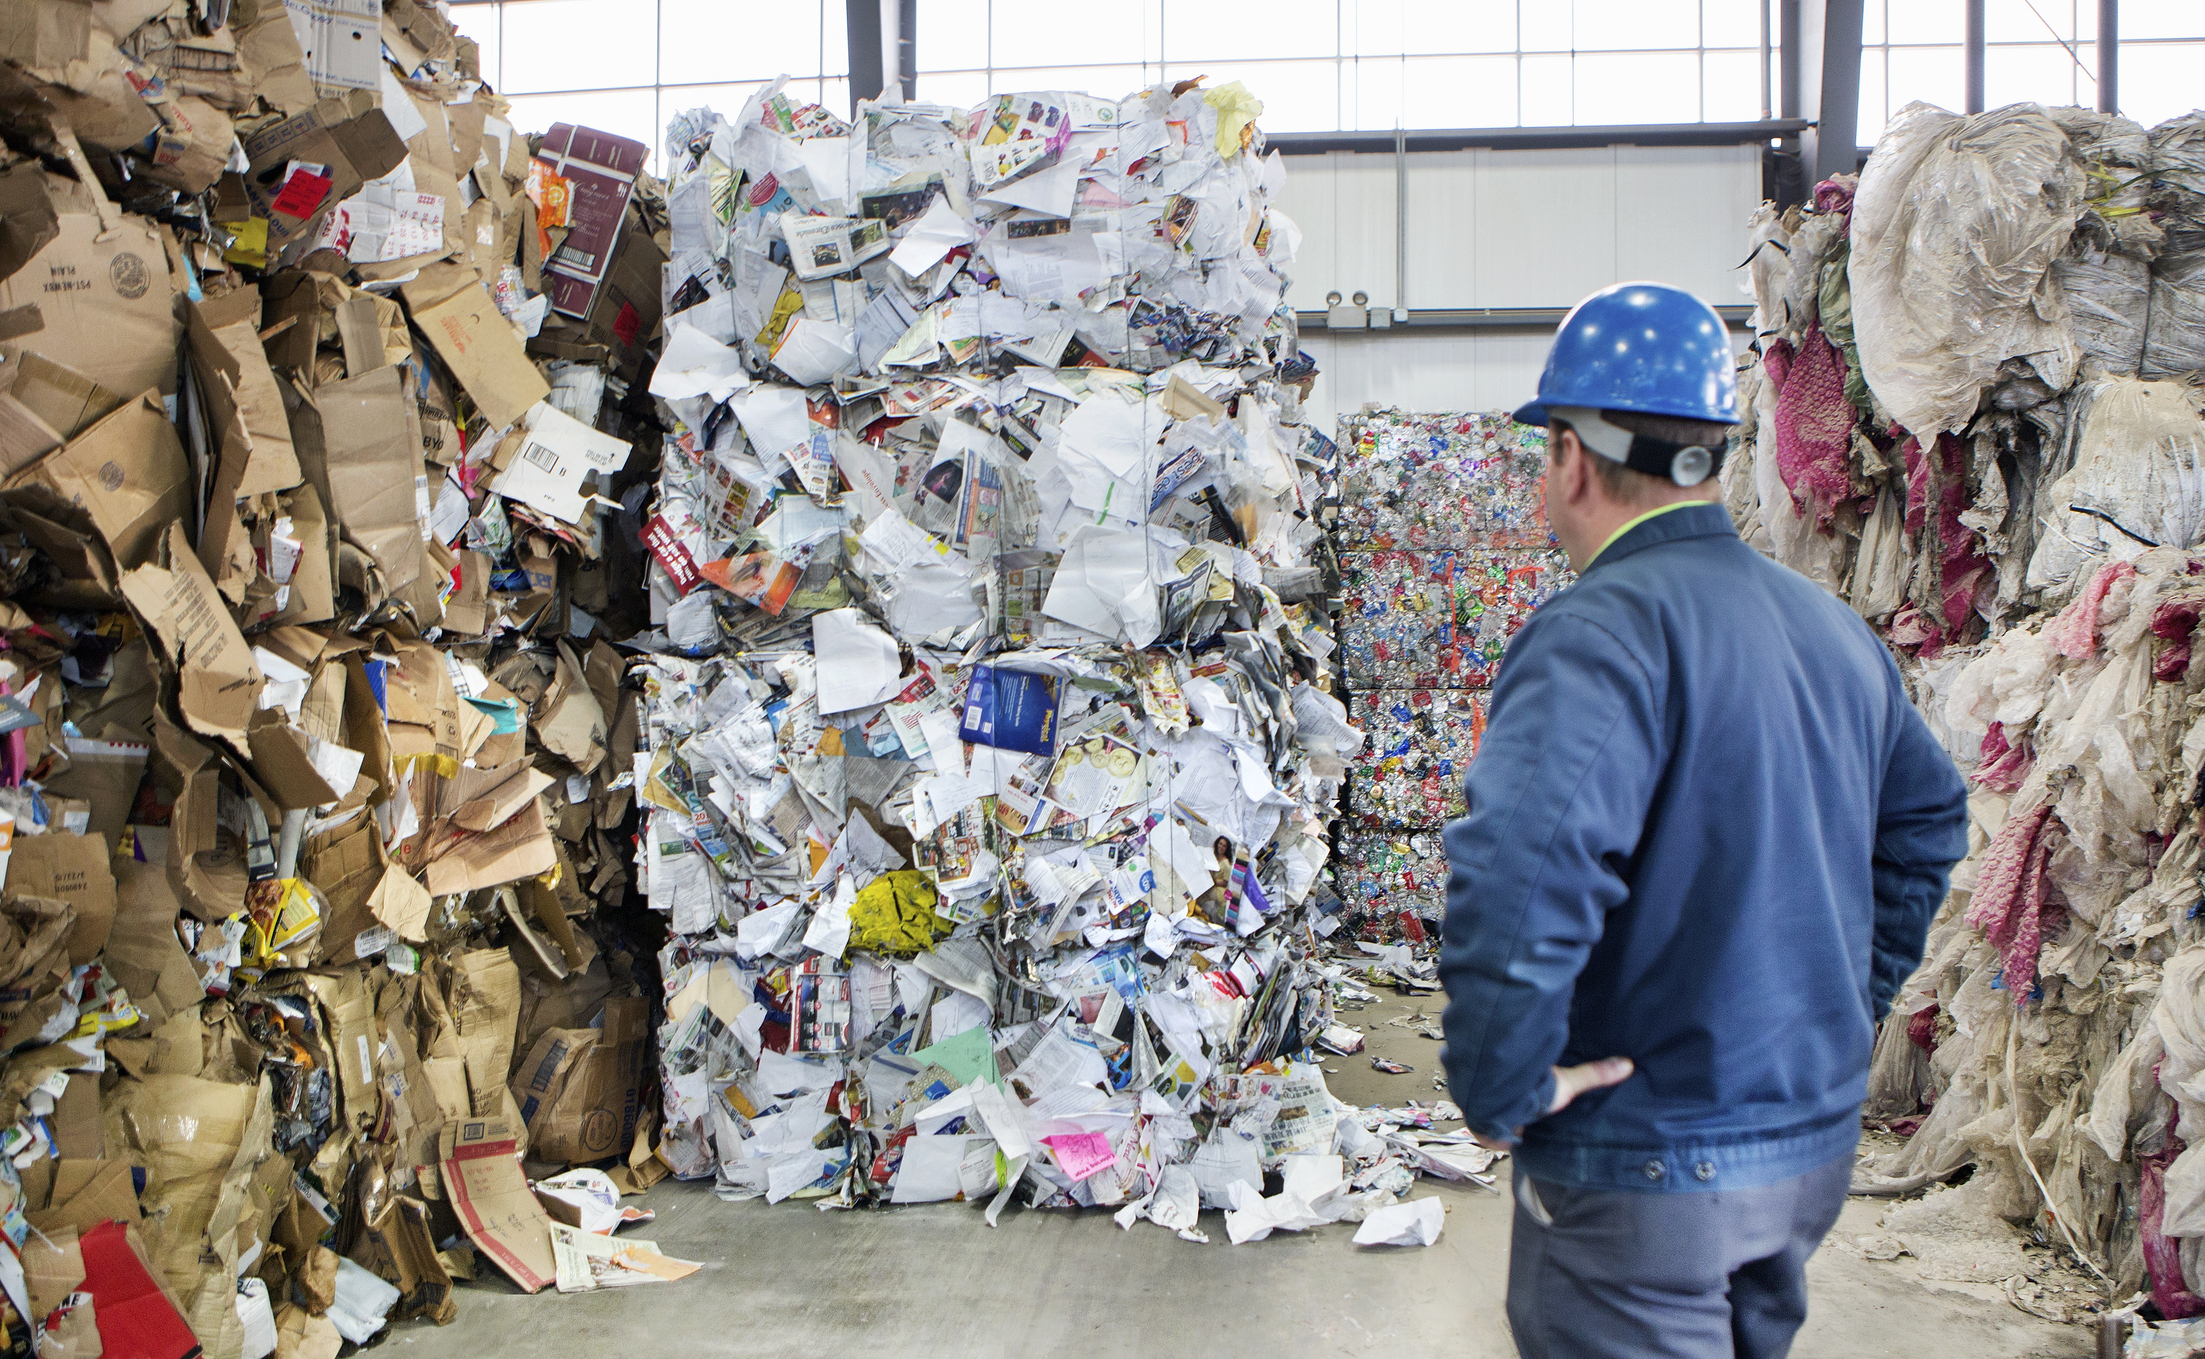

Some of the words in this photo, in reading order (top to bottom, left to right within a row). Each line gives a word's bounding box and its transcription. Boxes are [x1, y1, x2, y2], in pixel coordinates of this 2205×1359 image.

[1172, 453, 1203, 480] best
[861, 470, 882, 498] Envelope
[647, 532, 661, 548] that
[658, 545, 669, 558] car
[666, 543, 681, 558] salt
[666, 555, 674, 563] a
[677, 555, 688, 567] on
[669, 559, 688, 586] Design
